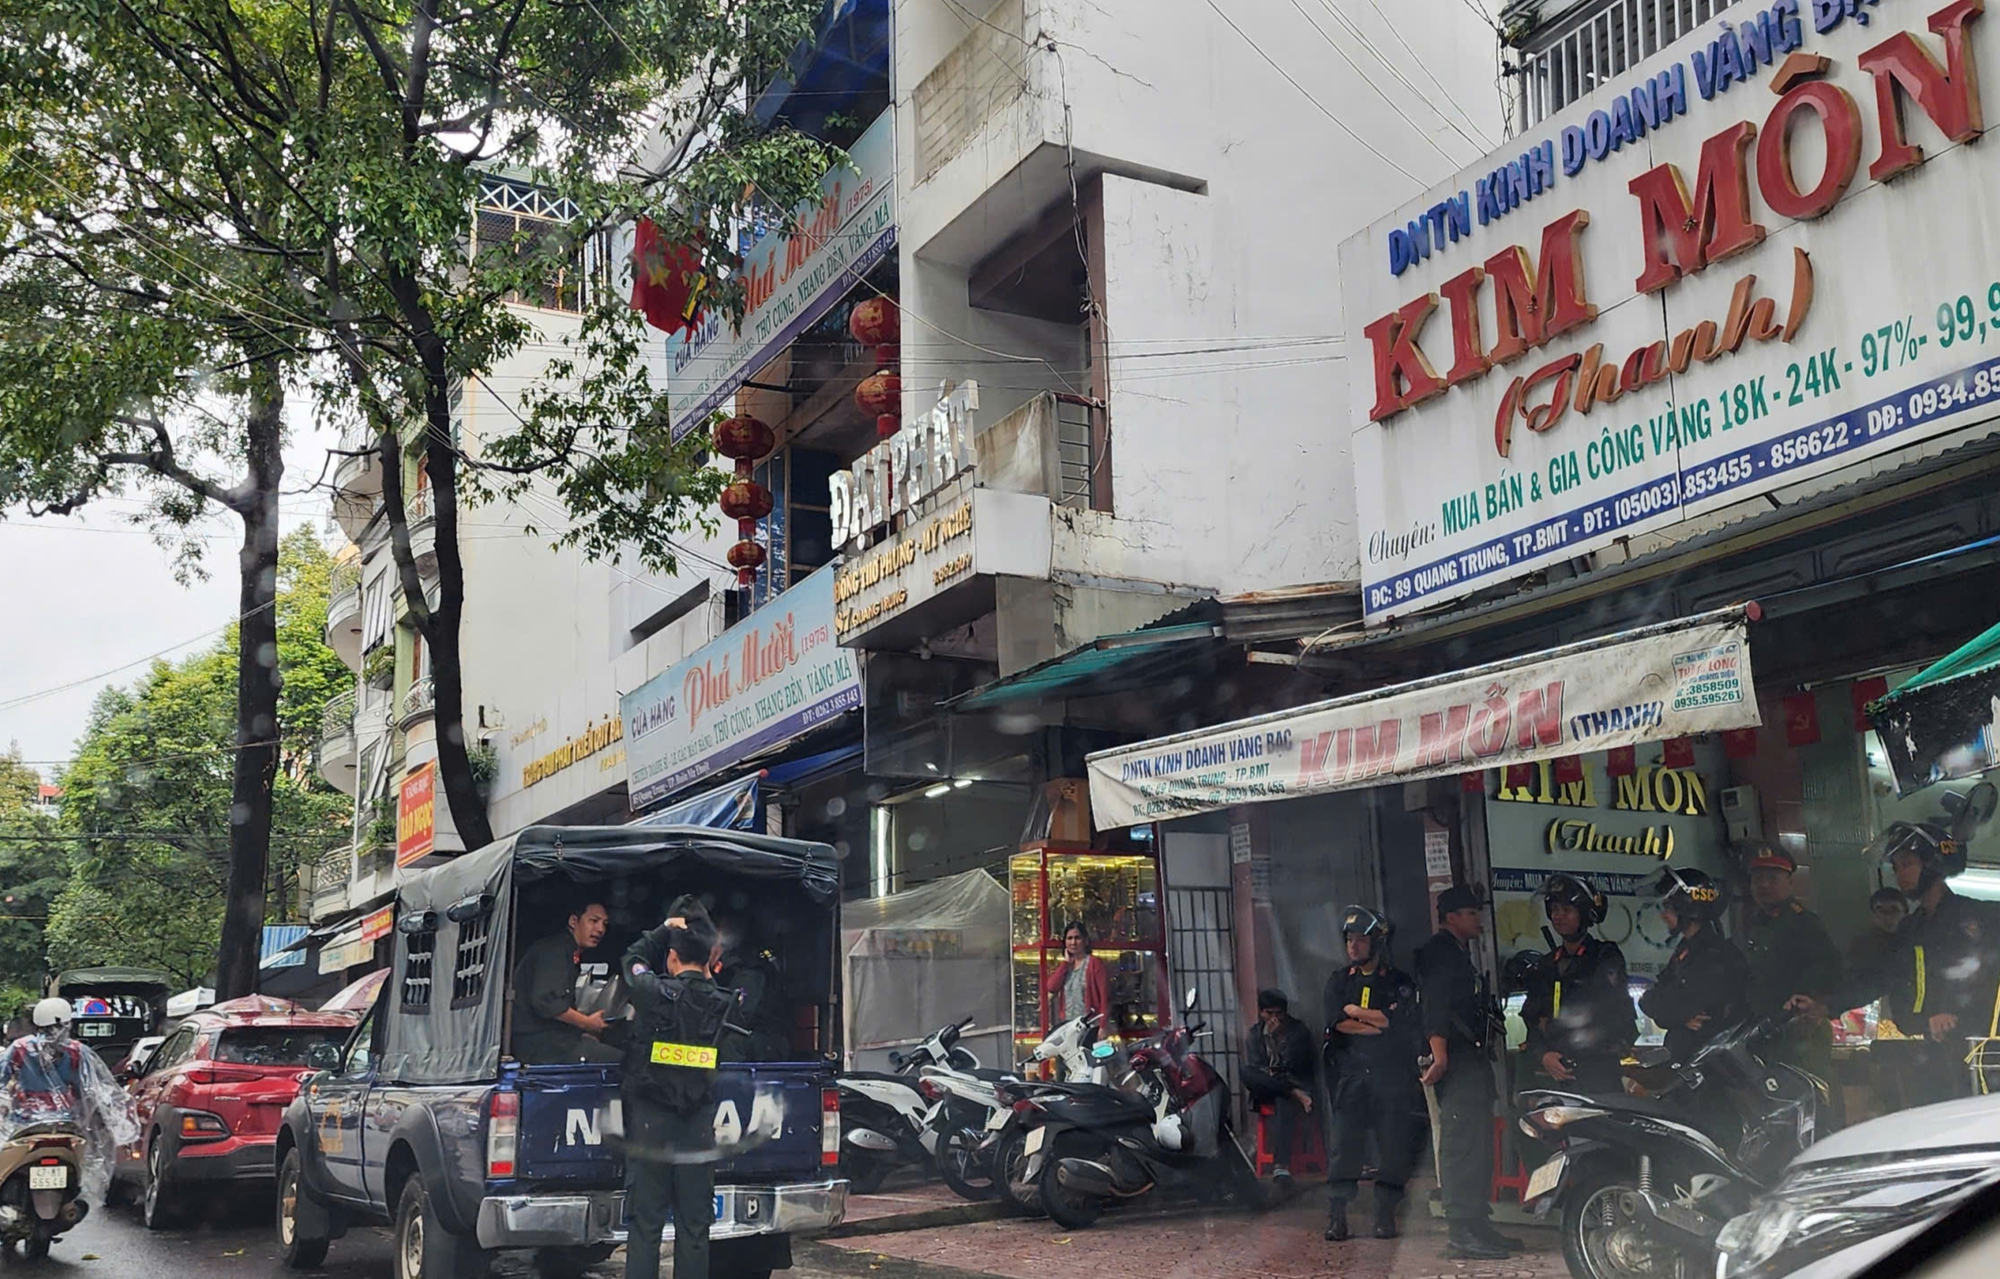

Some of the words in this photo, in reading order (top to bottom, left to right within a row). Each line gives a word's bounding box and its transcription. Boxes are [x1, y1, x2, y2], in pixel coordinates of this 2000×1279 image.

[1388, 190, 1471, 277] DNTN
[1475, 138, 1555, 226] KINH
[1561, 61, 1687, 177] DOANH
[1691, 0, 1804, 100] VÀNG
[845, 176, 873, 216] (1975)
[1364, 208, 1599, 422] KIM
[1627, 0, 1985, 295] MÔN
[797, 263, 826, 306] NHANG
[1368, 520, 1437, 564] Chuyên:
[1442, 490, 1480, 537] MUA
[1485, 467, 1523, 520] BÁN
[1530, 471, 1542, 503] &
[1548, 449, 1581, 495] GIA
[1586, 426, 1645, 481] CÔNG
[1649, 400, 1712, 456] VÀNG
[1719, 374, 1769, 432] 18K
[1786, 346, 1842, 407] 24K
[1371, 586, 1392, 609] ĐC:
[1394, 577, 1412, 600] 89
[1413, 560, 1458, 594] QUANG
[1458, 542, 1510, 577] TRUNG,
[1512, 519, 1569, 558] TP.BMT
[1583, 508, 1611, 535] ĐT:
[1770, 421, 1849, 469] 856622
[1867, 403, 1904, 437] DĐ:
[880, 538, 916, 580] PHỤNG
[800, 623, 829, 655] (1975)
[1708, 657, 1738, 672] LONG
[631, 706, 649, 739] CỬA
[650, 694, 676, 730] HÀNG
[713, 711, 729, 744] THỜ
[754, 690, 785, 724] NHANG
[807, 663, 834, 695] VÀNG
[846, 689, 859, 705] 143
[1674, 689, 1741, 709] 0935.595261
[1121, 757, 1152, 783] DNTN
[1154, 751, 1182, 777] KINH
[1186, 743, 1226, 770] DOANH
[1231, 734, 1262, 761] VÀNG
[1266, 728, 1293, 758] BẠC
[1295, 718, 1401, 789] KIM
[1415, 681, 1566, 768] MÔN
[1569, 700, 1664, 742] (THANH)
[1198, 771, 1226, 789] TRUNG
[1549, 817, 1675, 861] (Thanh)
[659, 1047, 713, 1063] CSCĐ
